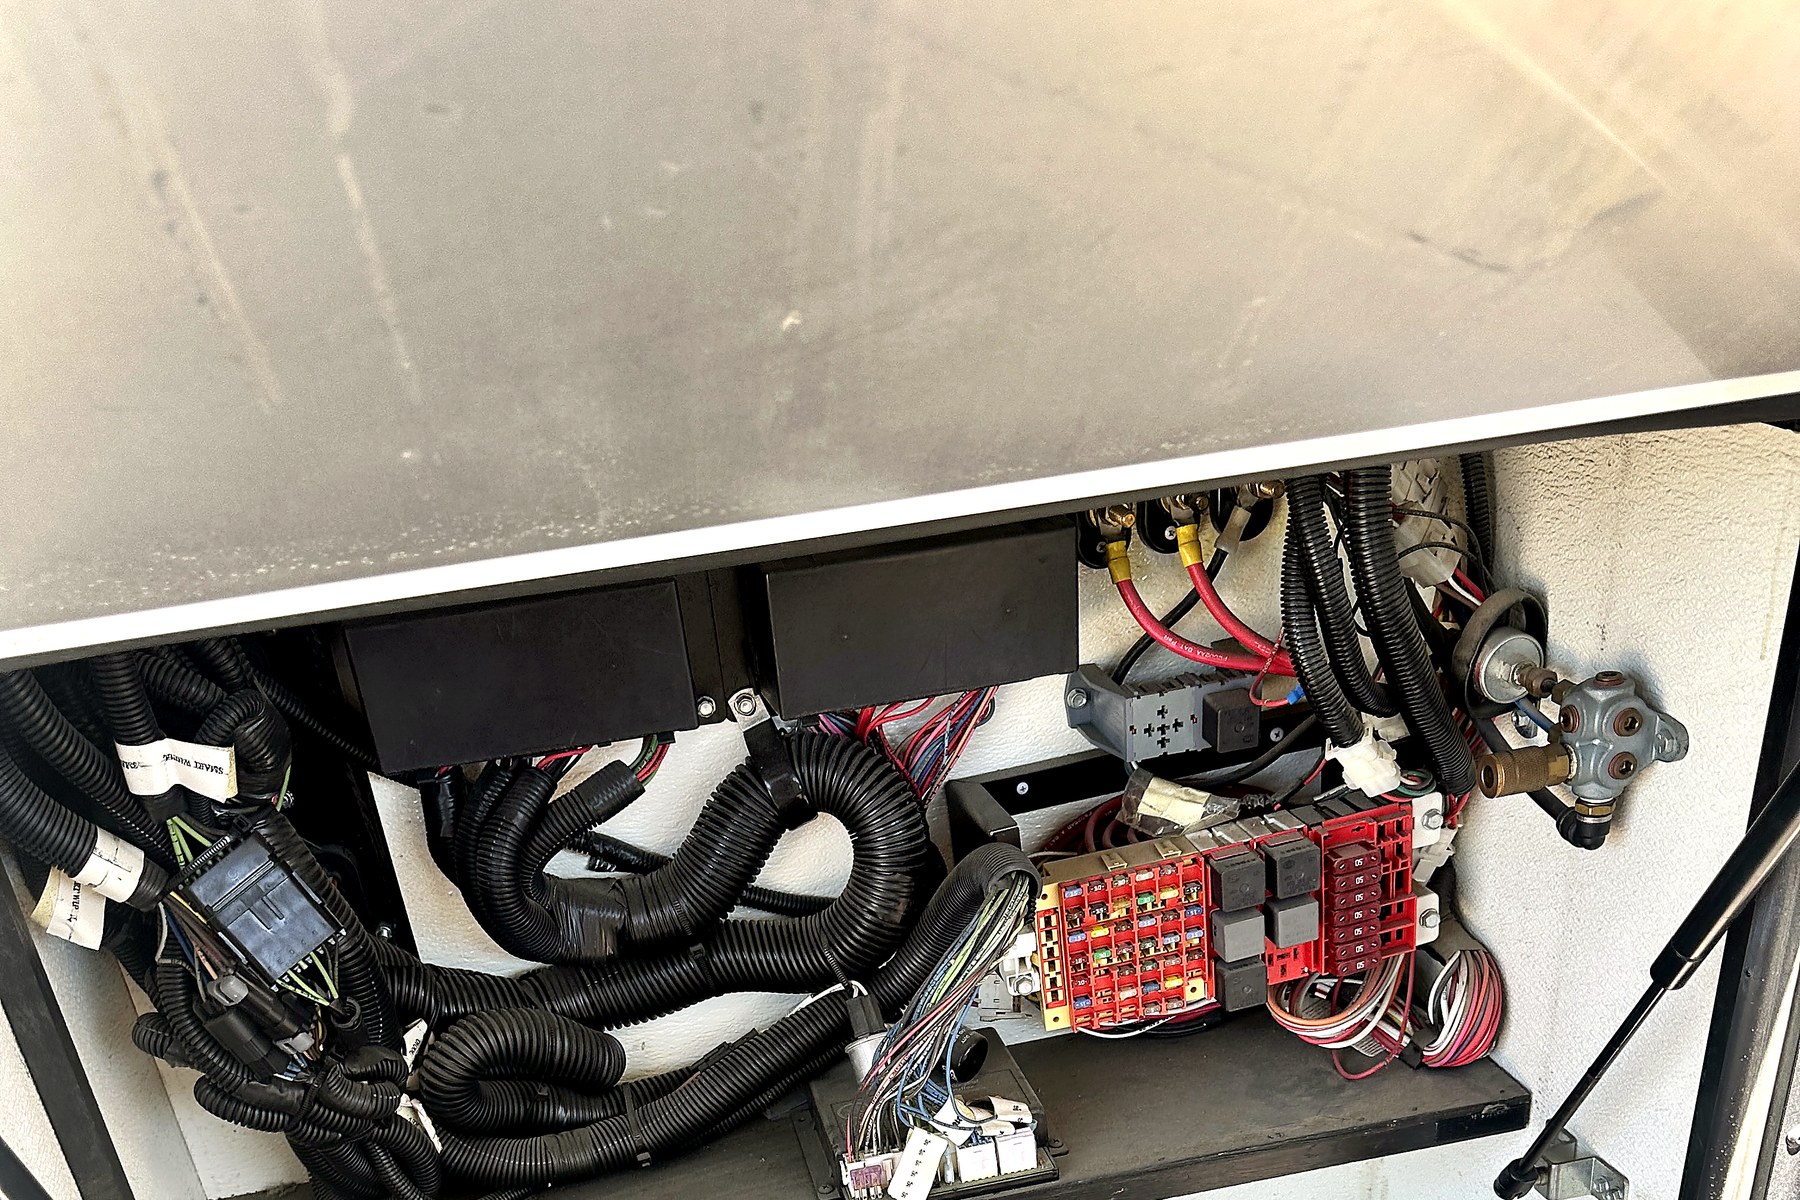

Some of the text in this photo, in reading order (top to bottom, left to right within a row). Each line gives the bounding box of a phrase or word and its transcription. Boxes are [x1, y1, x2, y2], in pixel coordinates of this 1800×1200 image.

[1354, 857, 1364, 867] 50
[1355, 875, 1364, 885] 50
[1355, 893, 1364, 902] 50
[1354, 910, 1363, 919] 50
[1354, 927, 1363, 936] 50
[1355, 944, 1364, 953] 50
[1356, 960, 1365, 970] 50
